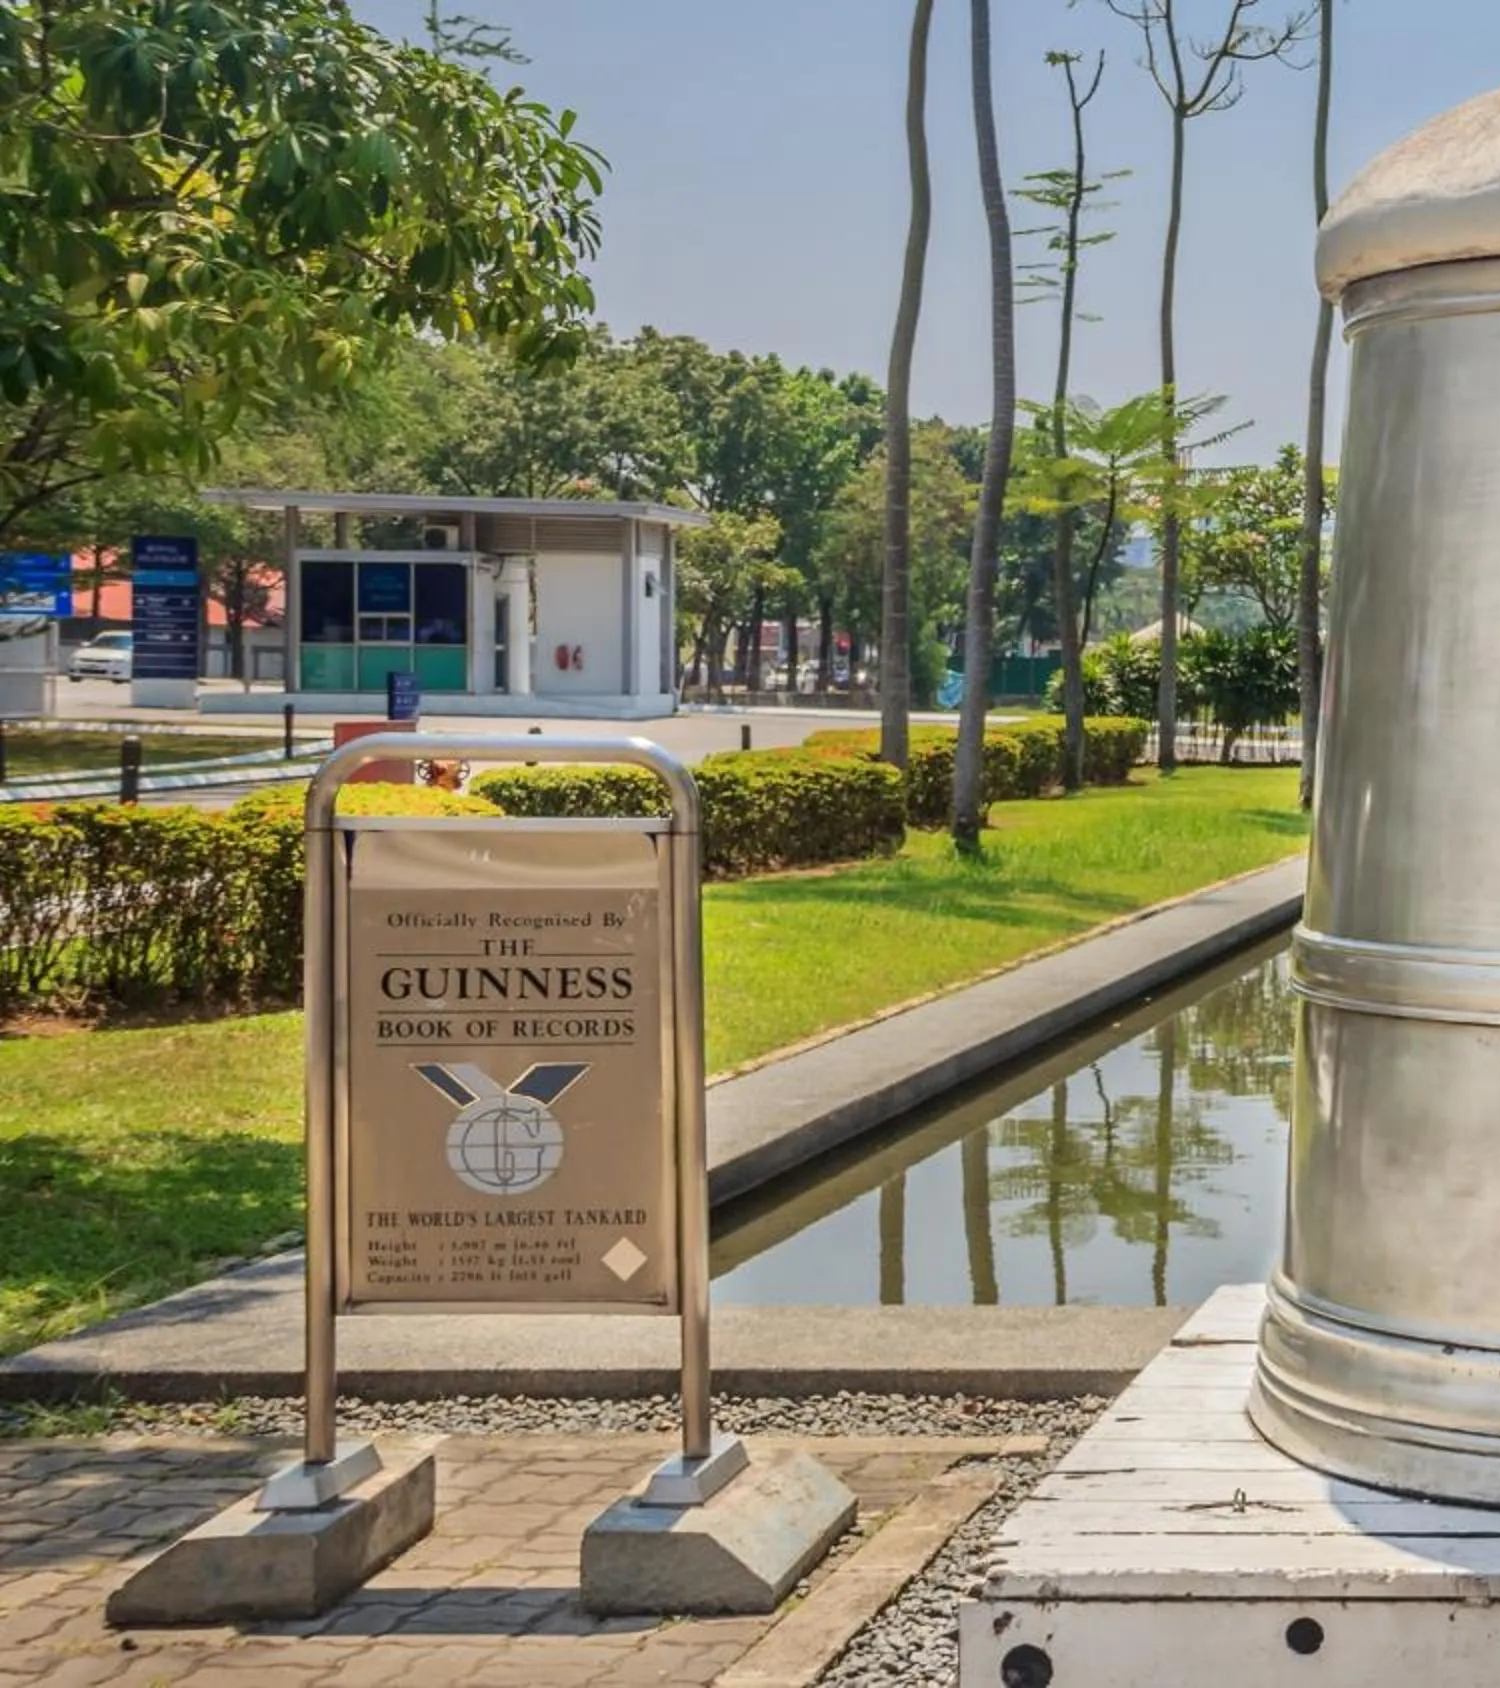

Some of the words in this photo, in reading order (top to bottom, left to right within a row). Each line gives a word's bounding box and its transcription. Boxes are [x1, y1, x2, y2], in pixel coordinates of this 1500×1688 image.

[387, 911, 477, 929] Officially
[489, 911, 592, 930] Recognised
[603, 911, 626, 928] By
[480, 938, 536, 957] THE
[380, 966, 634, 1000] GUINNESS
[377, 1019, 453, 1039] BOOK
[465, 1019, 500, 1038] OF
[512, 1018, 636, 1038] RECORDS
[365, 1211, 400, 1228] THE
[484, 1209, 556, 1227] LARGEST
[564, 1208, 648, 1226] TANKARD
